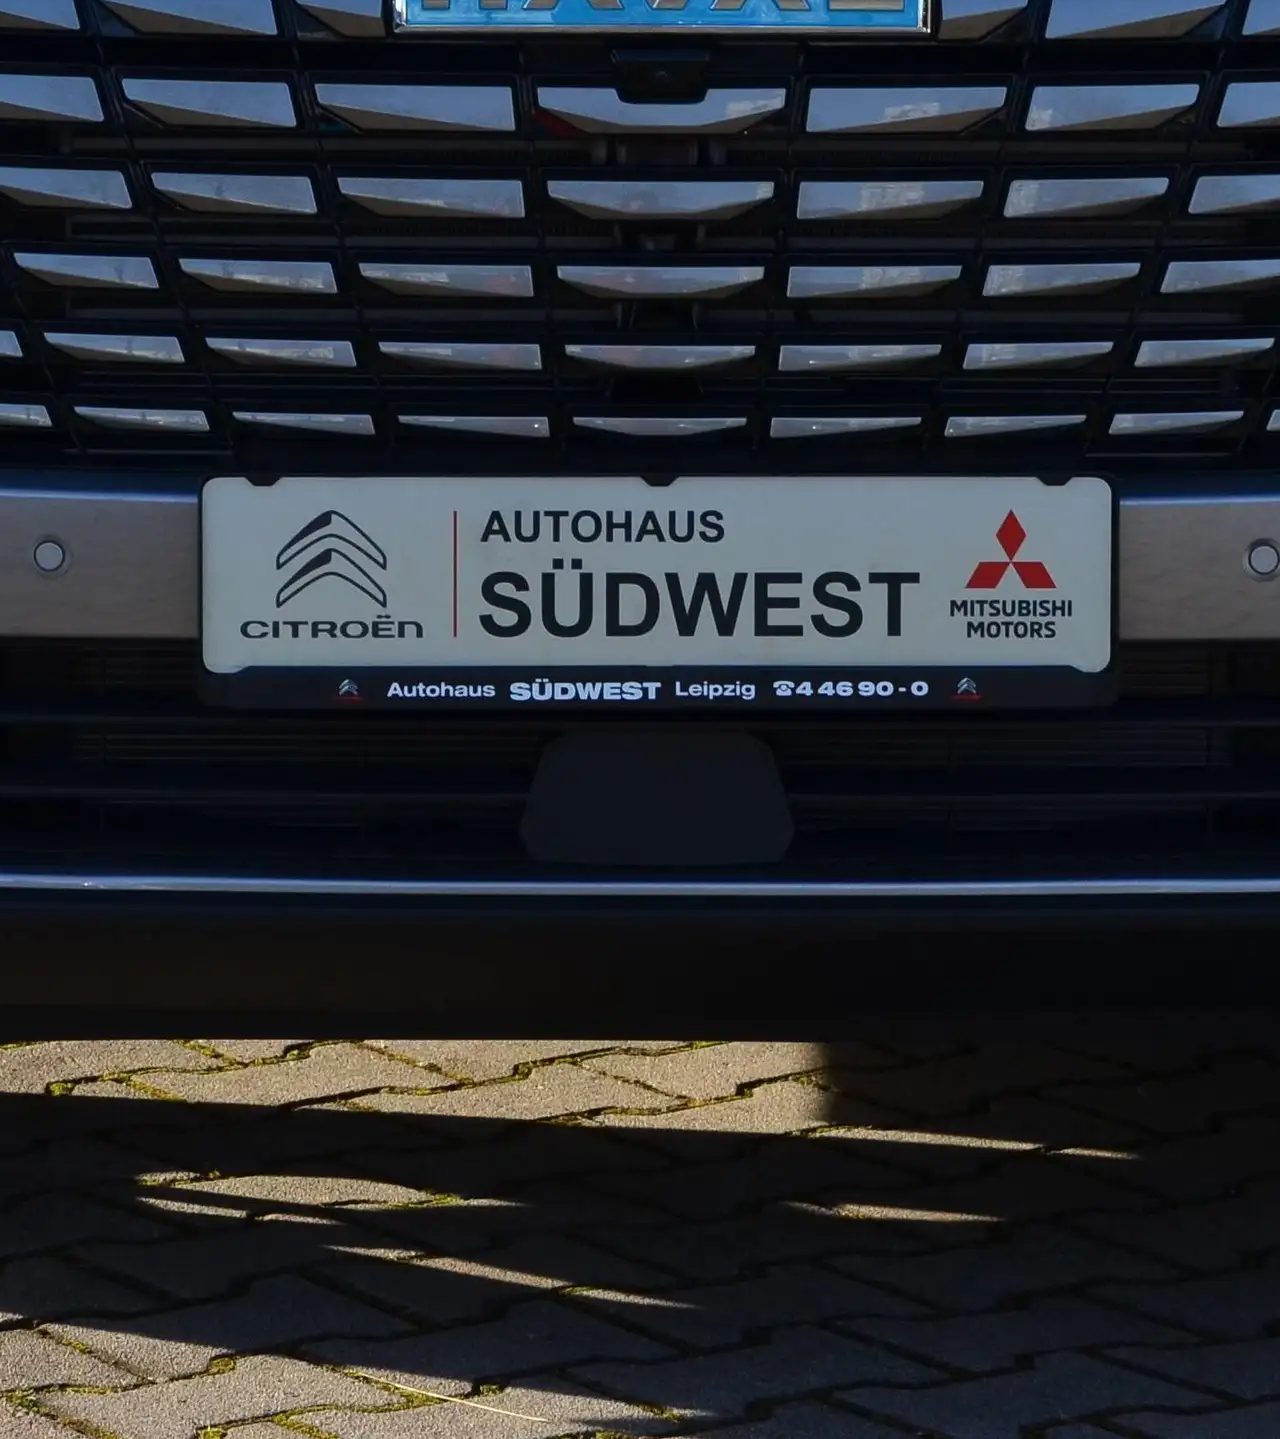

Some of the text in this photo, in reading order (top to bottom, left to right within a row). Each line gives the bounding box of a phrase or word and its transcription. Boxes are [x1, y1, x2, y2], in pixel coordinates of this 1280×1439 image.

[480, 509, 725, 543] AUTOHAUS
[478, 557, 921, 638] SÜDWEST
[949, 599, 1073, 618] MITSUBISHI
[966, 620, 1057, 639] MOTORS
[387, 681, 496, 698] Autohaus
[509, 678, 662, 701] SÜDWEST
[675, 680, 756, 700] Leipzig
